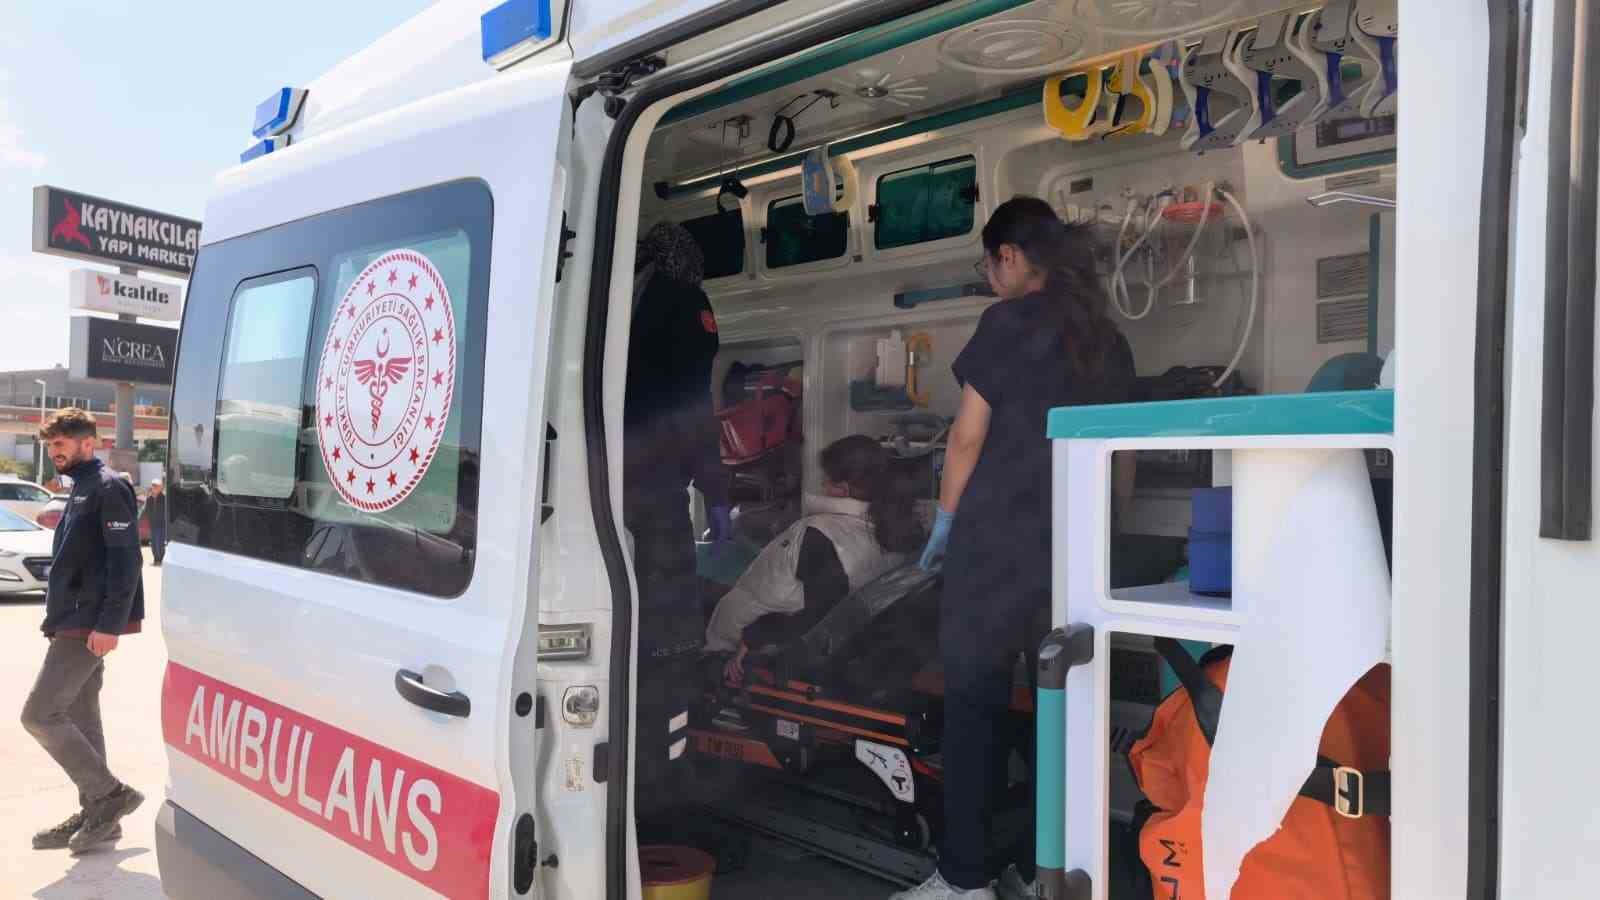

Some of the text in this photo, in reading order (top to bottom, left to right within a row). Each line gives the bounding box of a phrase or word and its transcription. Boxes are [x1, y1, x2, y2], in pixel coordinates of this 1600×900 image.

[81, 203, 202, 250] KAYNAKÇILA
[99, 236, 194, 267] YAPI MARKET
[114, 280, 169, 304] kalde
[398, 303, 425, 347] SAĞLIK
[394, 355, 424, 448] BAKANLIĞI
[185, 685, 442, 872] AMBULANS
